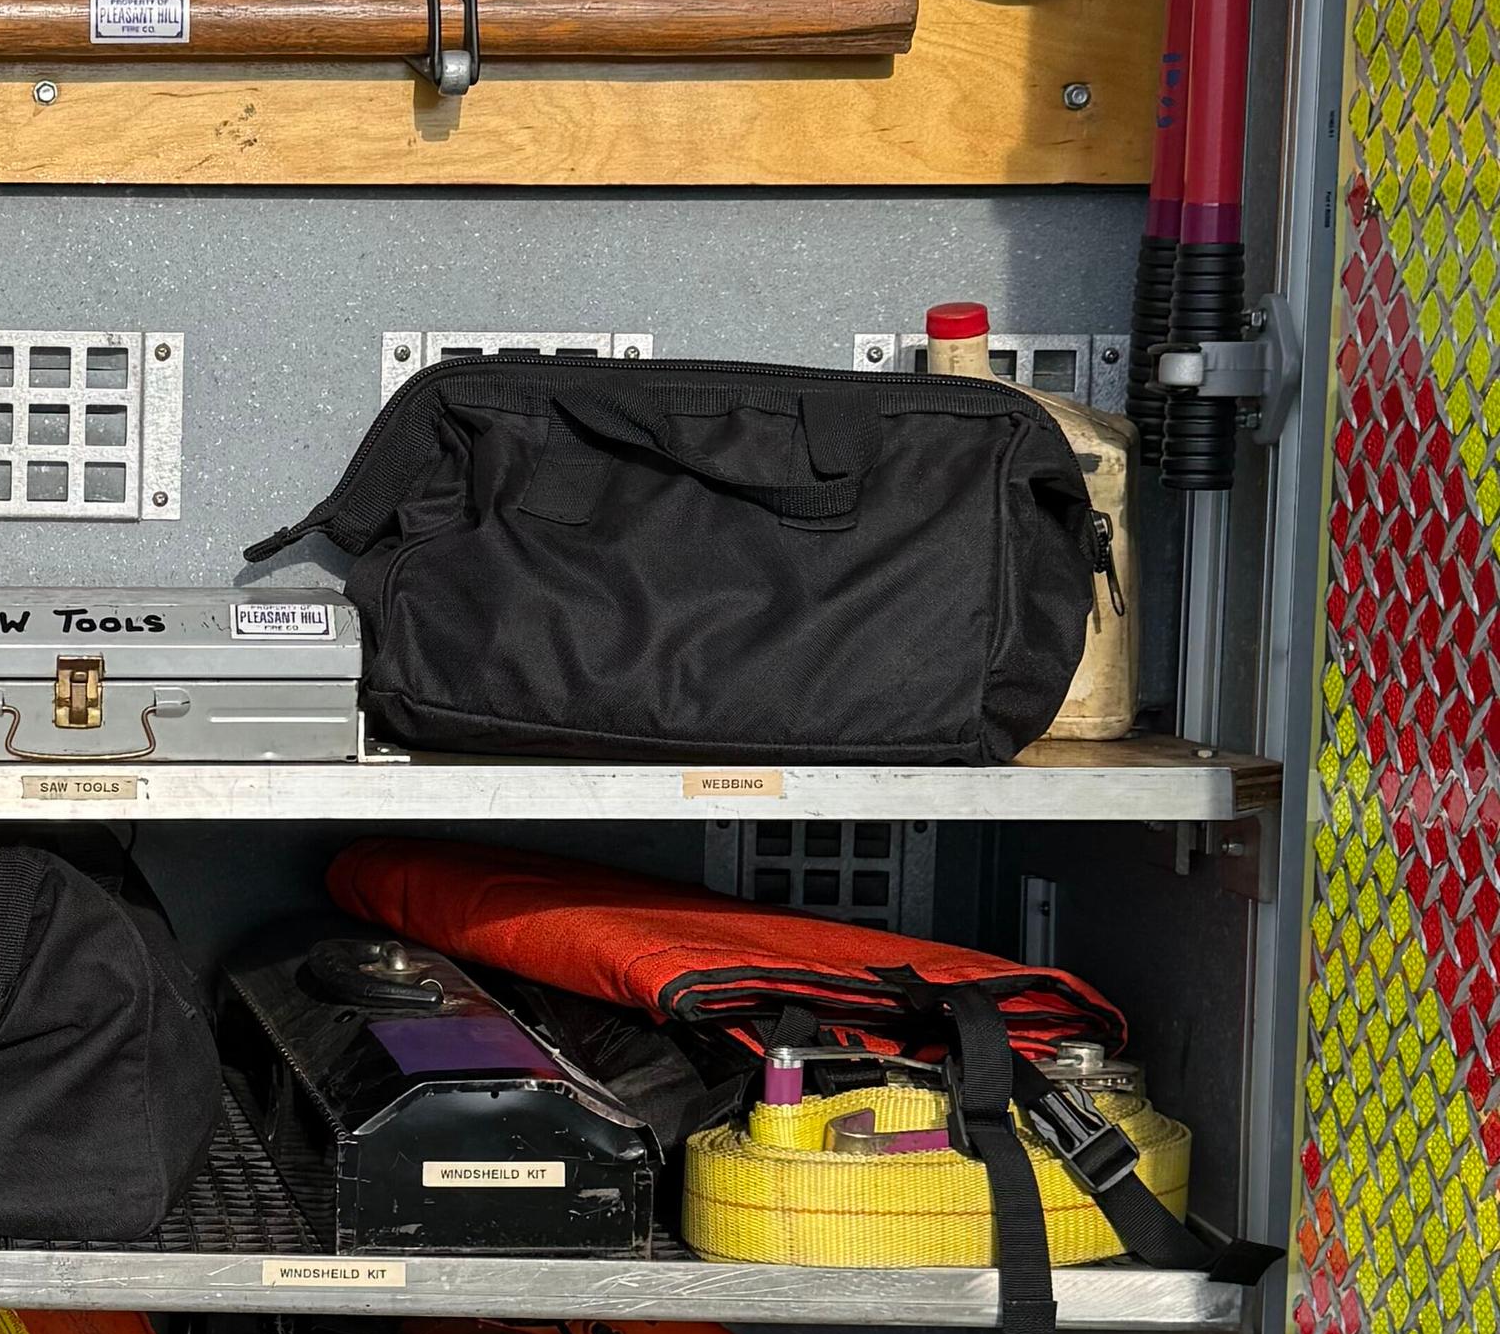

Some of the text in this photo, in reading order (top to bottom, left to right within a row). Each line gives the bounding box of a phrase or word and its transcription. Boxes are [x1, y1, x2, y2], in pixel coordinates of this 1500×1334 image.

[100, 7, 180, 24] PLEASANT HILL
[239, 610, 325, 625] PLEASANT HILL
[40, 782, 120, 793] SAW TOOLS
[701, 779, 764, 790] WEBBING
[440, 1169, 547, 1180] WINDSHEILD KIT
[280, 1268, 387, 1279] WINDSHEILD KIT
